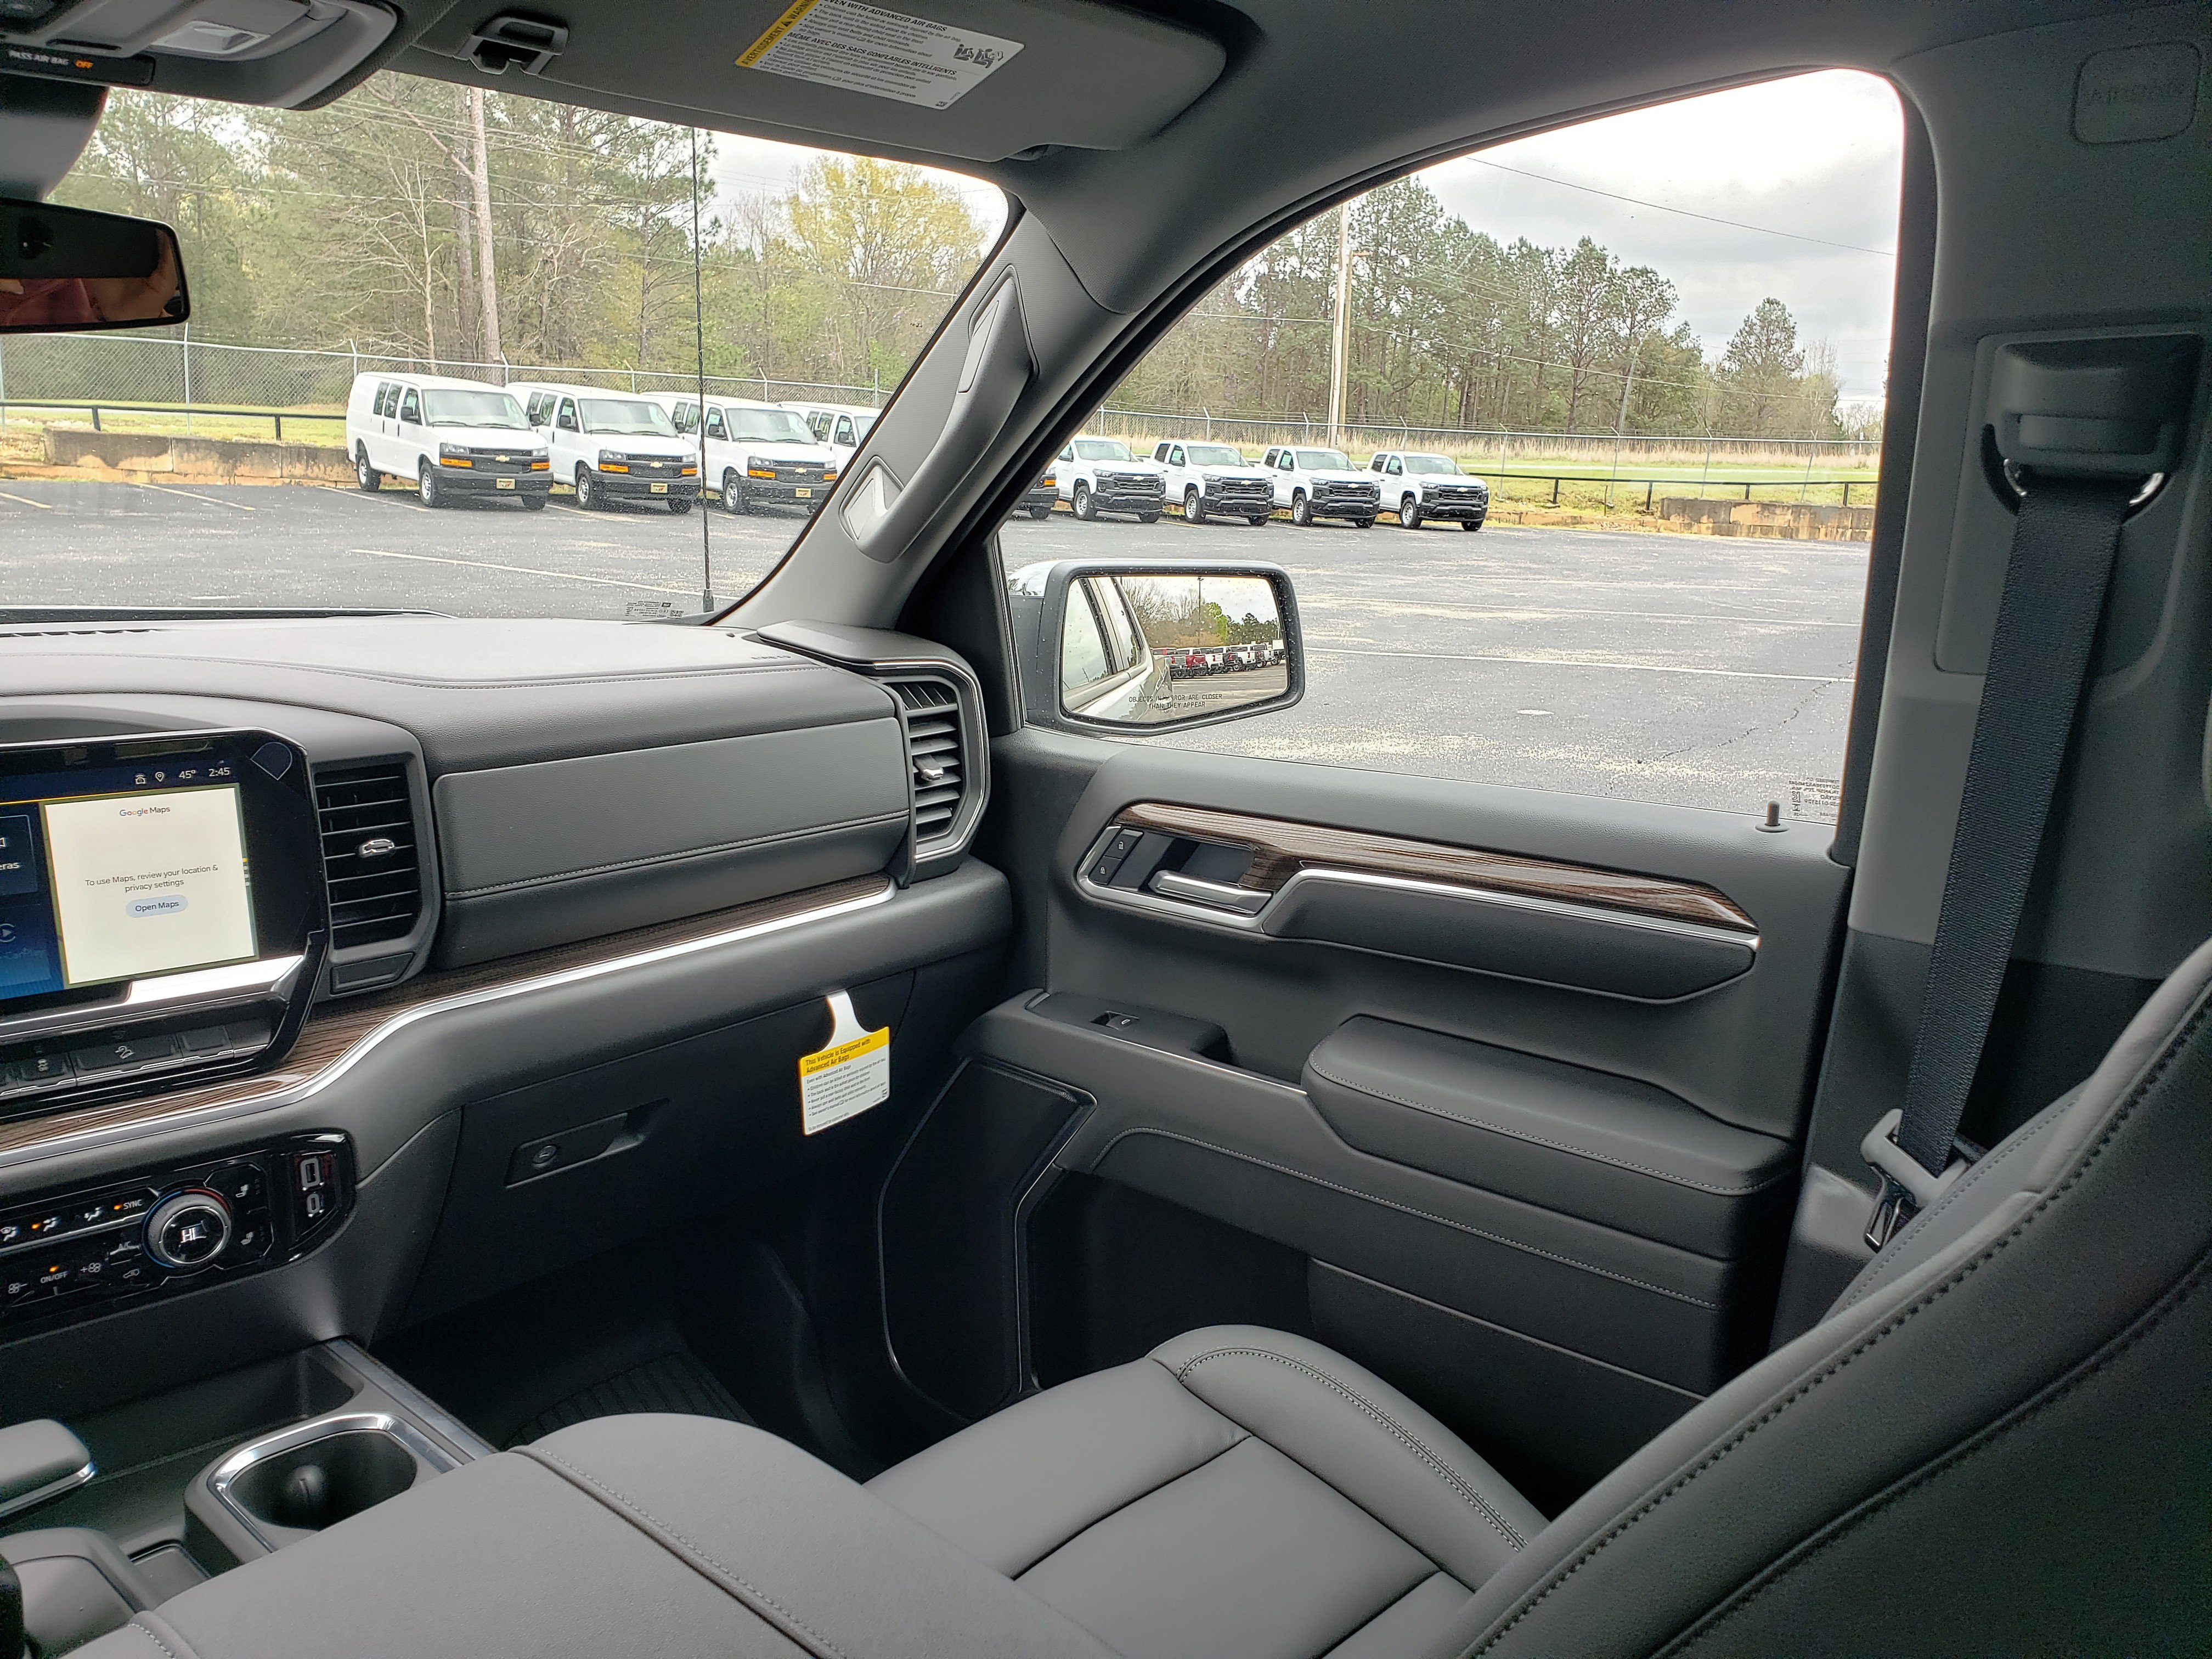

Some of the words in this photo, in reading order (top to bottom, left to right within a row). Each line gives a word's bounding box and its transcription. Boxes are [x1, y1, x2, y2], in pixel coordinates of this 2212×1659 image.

[847, 2, 868, 11] WITH
[868, 8, 911, 22] ADVANCED
[926, 23, 947, 31] BAGS
[742, 26, 785, 65] AVERTISSEMENT
[787, 32, 811, 41] MÊME
[867, 50, 911, 65] GONFLABLES
[911, 61, 957, 75] INTELLIGENTS
[75, 60, 93, 68] OFF
[208, 767, 230, 777] 2:45
[120, 808, 148, 816] Google
[112, 875, 136, 884] Maps,
[163, 870, 180, 878] your
[182, 866, 211, 874] location
[125, 883, 153, 893] privacy
[154, 879, 184, 888] settings
[136, 904, 157, 912] Open
[159, 901, 179, 909] Maps
[817, 1052, 834, 1062] Vehicle
[840, 1042, 860, 1054] Equipped
[807, 1060, 830, 1073] Advanced
[123, 1199, 143, 1210] SYNC
[182, 1227, 195, 1242] HI
[40, 1271, 70, 1284] ON/OFF
